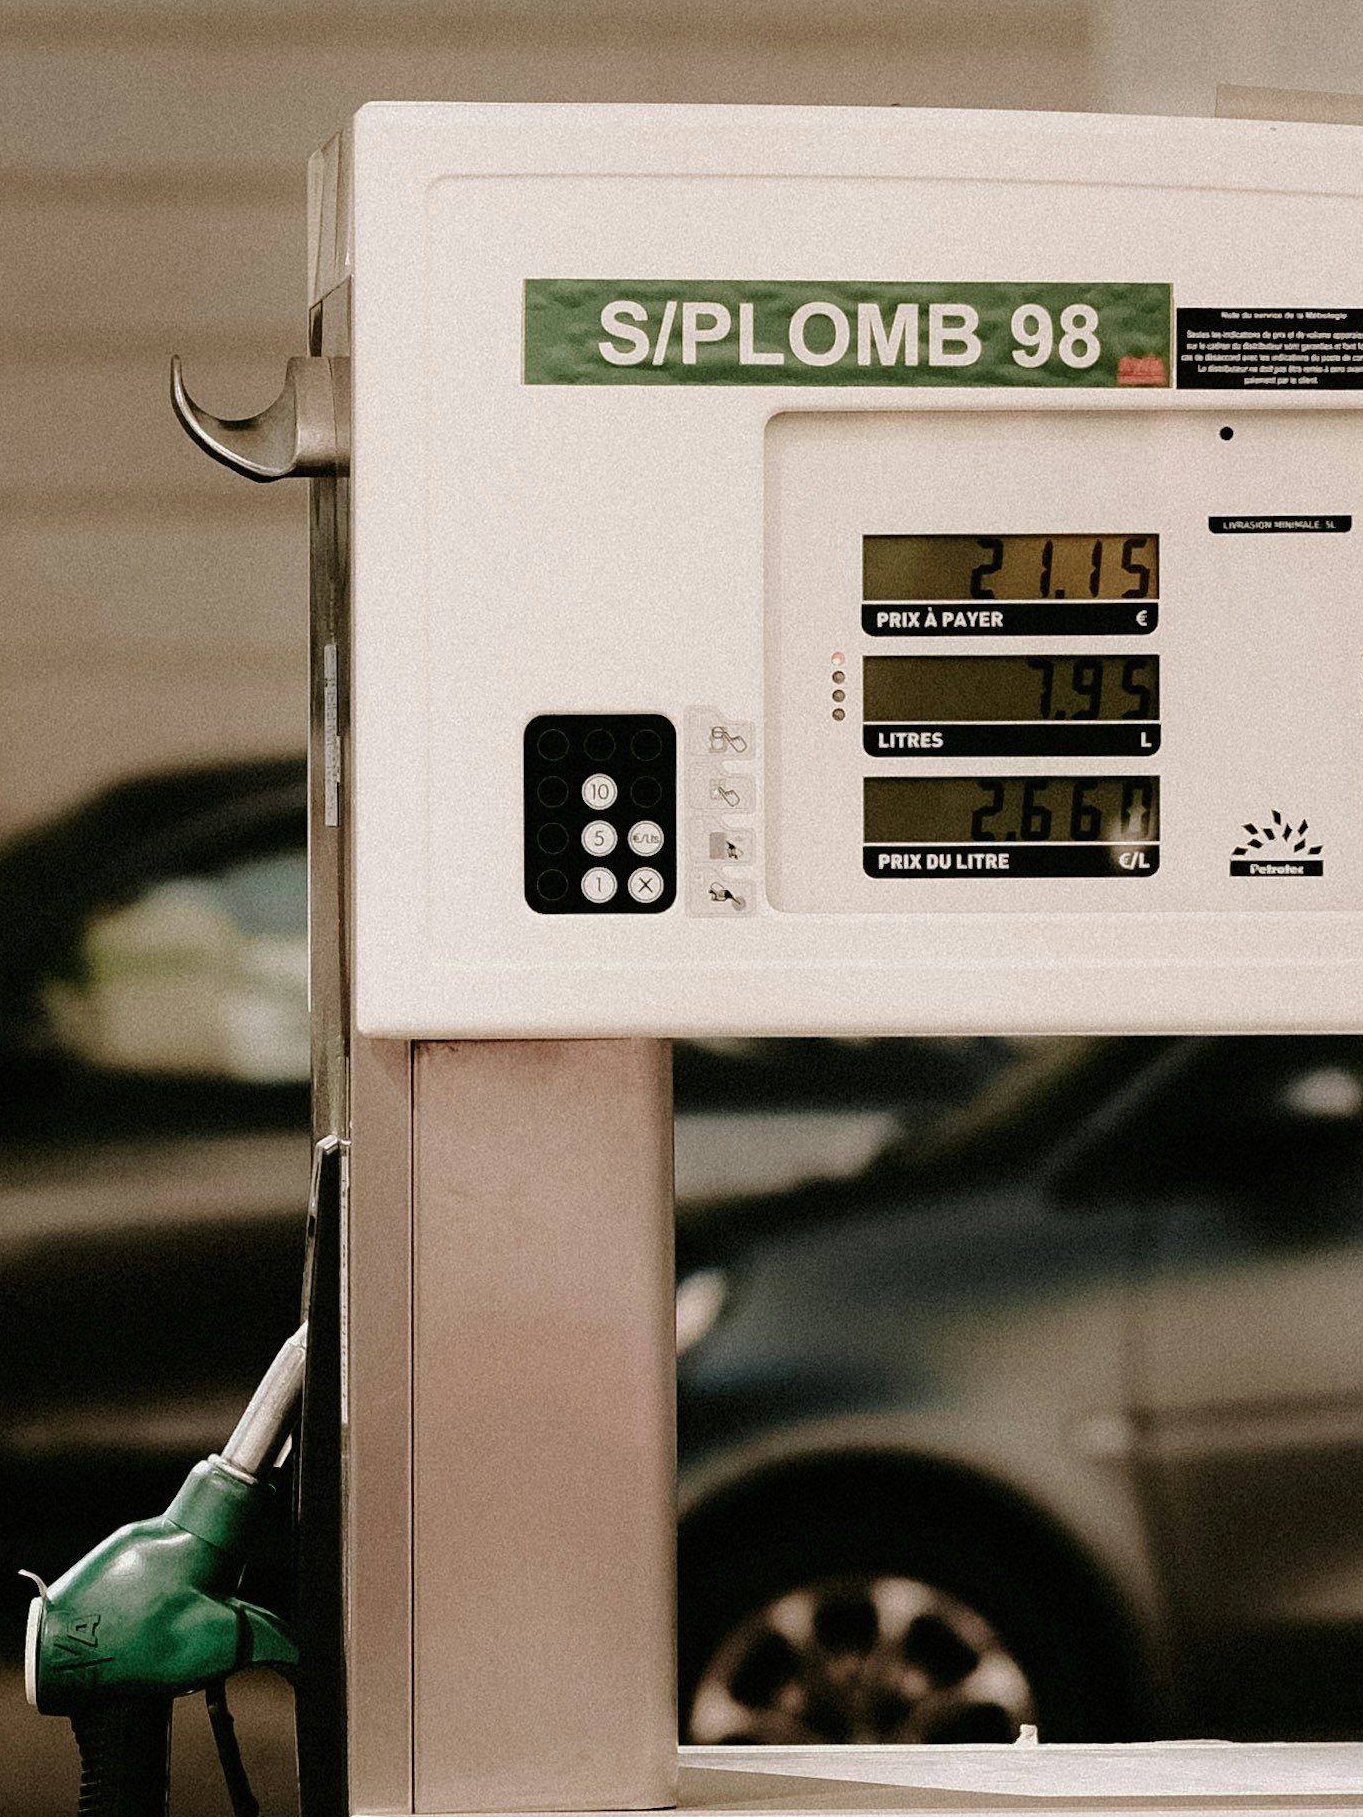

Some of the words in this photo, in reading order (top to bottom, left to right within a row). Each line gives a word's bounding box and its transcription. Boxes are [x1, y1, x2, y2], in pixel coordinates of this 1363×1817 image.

[598, 300, 982, 369] S/PLOMB
[1010, 304, 1101, 369] 98
[970, 537, 1151, 599] 21.15
[876, 612, 920, 628] PRIX
[924, 607, 937, 627] À
[942, 611, 1004, 628] PAYER
[1136, 609, 1148, 627] €
[1027, 657, 1151, 720] 7.95
[878, 732, 944, 748] LITRES
[1140, 732, 1152, 748] L
[590, 783, 609, 800] 10
[594, 830, 604, 846] 5
[878, 853, 922, 870] PRIX
[926, 854, 951, 869] DU
[956, 853, 1010, 869] LITRE
[1118, 852, 1150, 870] €/L
